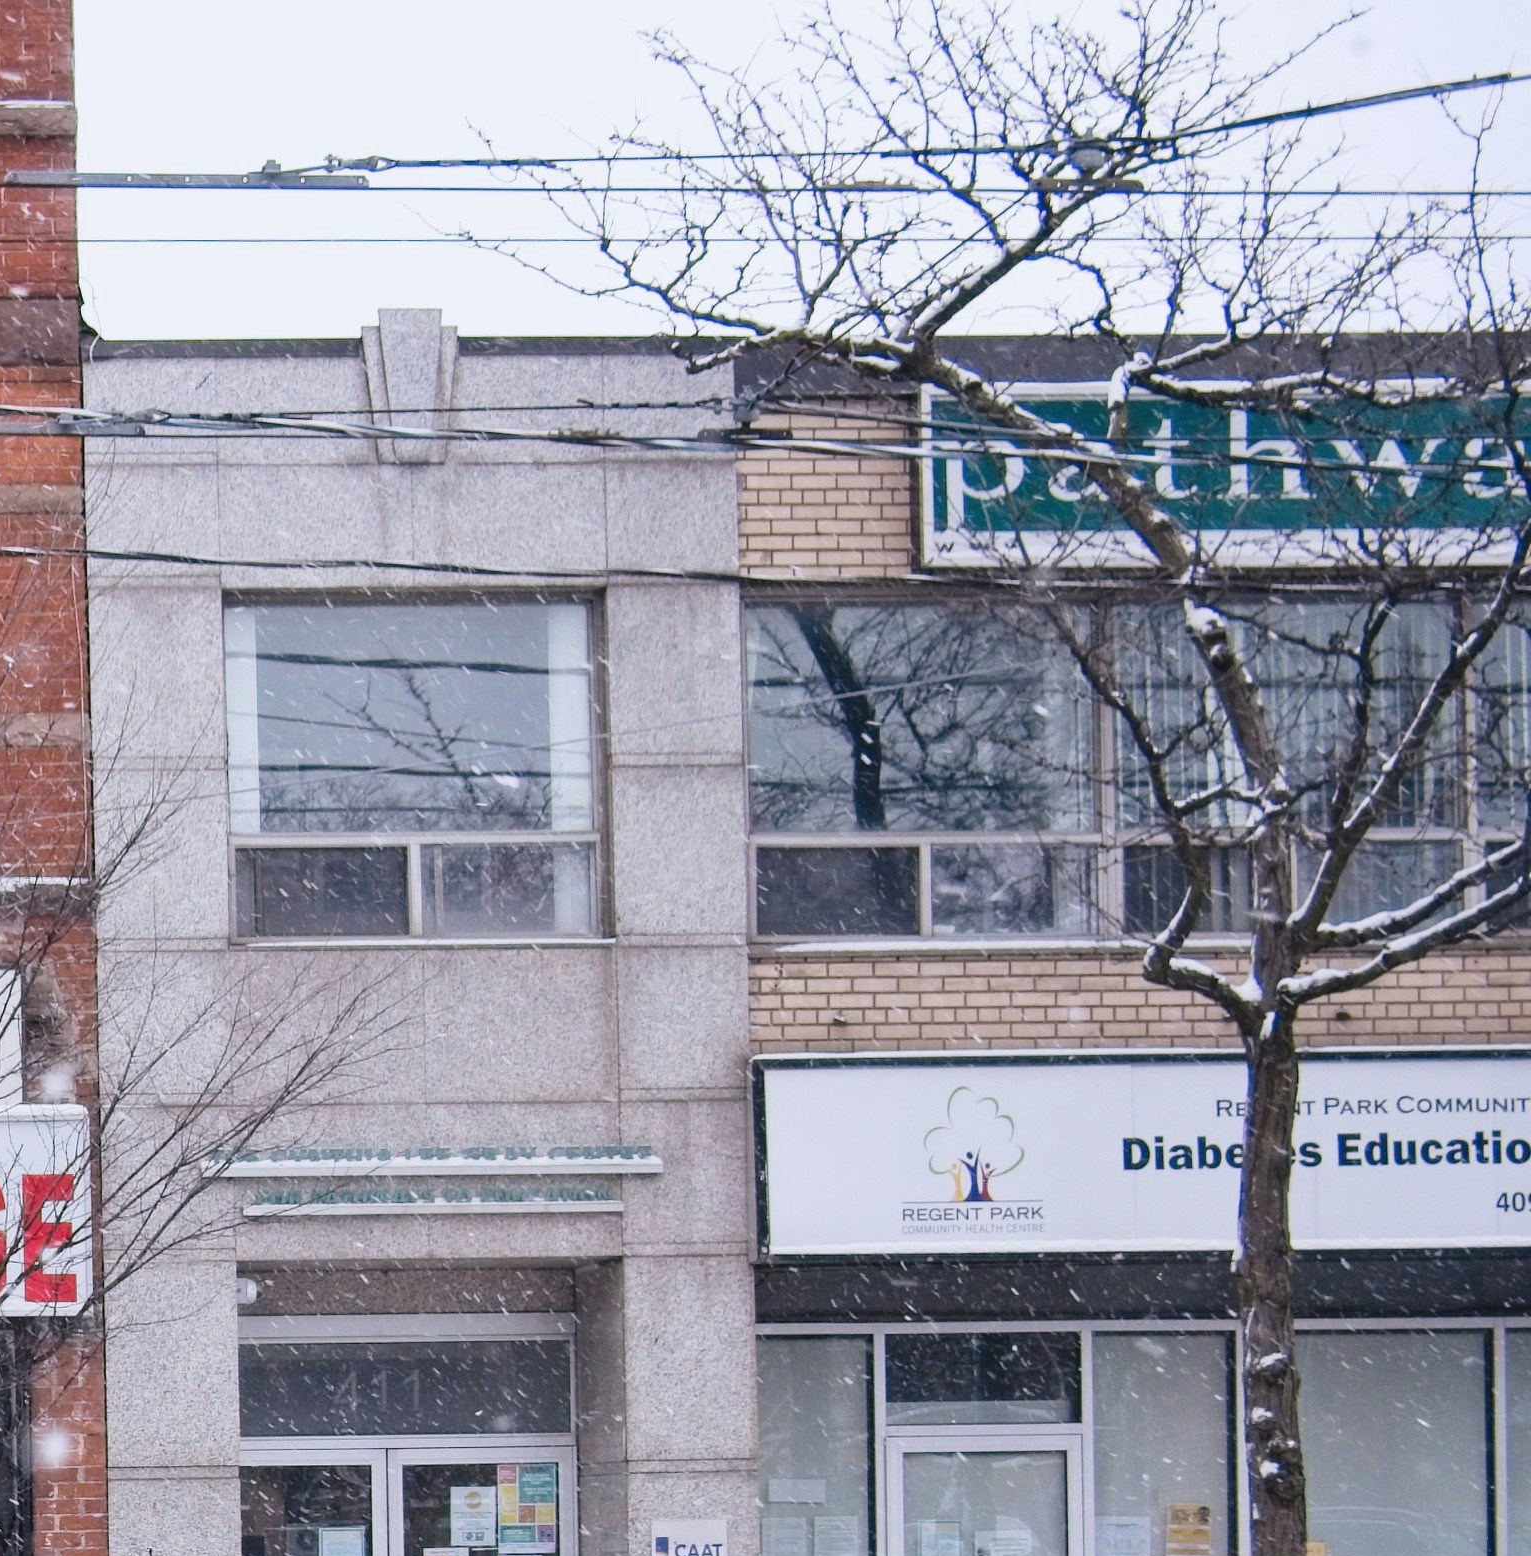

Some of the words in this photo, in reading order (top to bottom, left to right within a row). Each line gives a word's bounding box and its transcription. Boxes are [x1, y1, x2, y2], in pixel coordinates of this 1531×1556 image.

[933, 407, 1531, 531] pthwa
[1216, 1099, 1316, 1117] RENT
[1324, 1097, 1389, 1114] PARK
[1123, 1136, 1322, 1170] Diabes
[1337, 1130, 1531, 1166] Educatio
[1496, 1192, 1531, 1212] 40
[902, 1208, 983, 1221] REGENT
[990, 1206, 1044, 1220] PARK
[901, 1224, 962, 1234] COMMUNITY
[966, 1223, 1003, 1234] HEALTH
[1006, 1223, 1045, 1233] CENTRE
